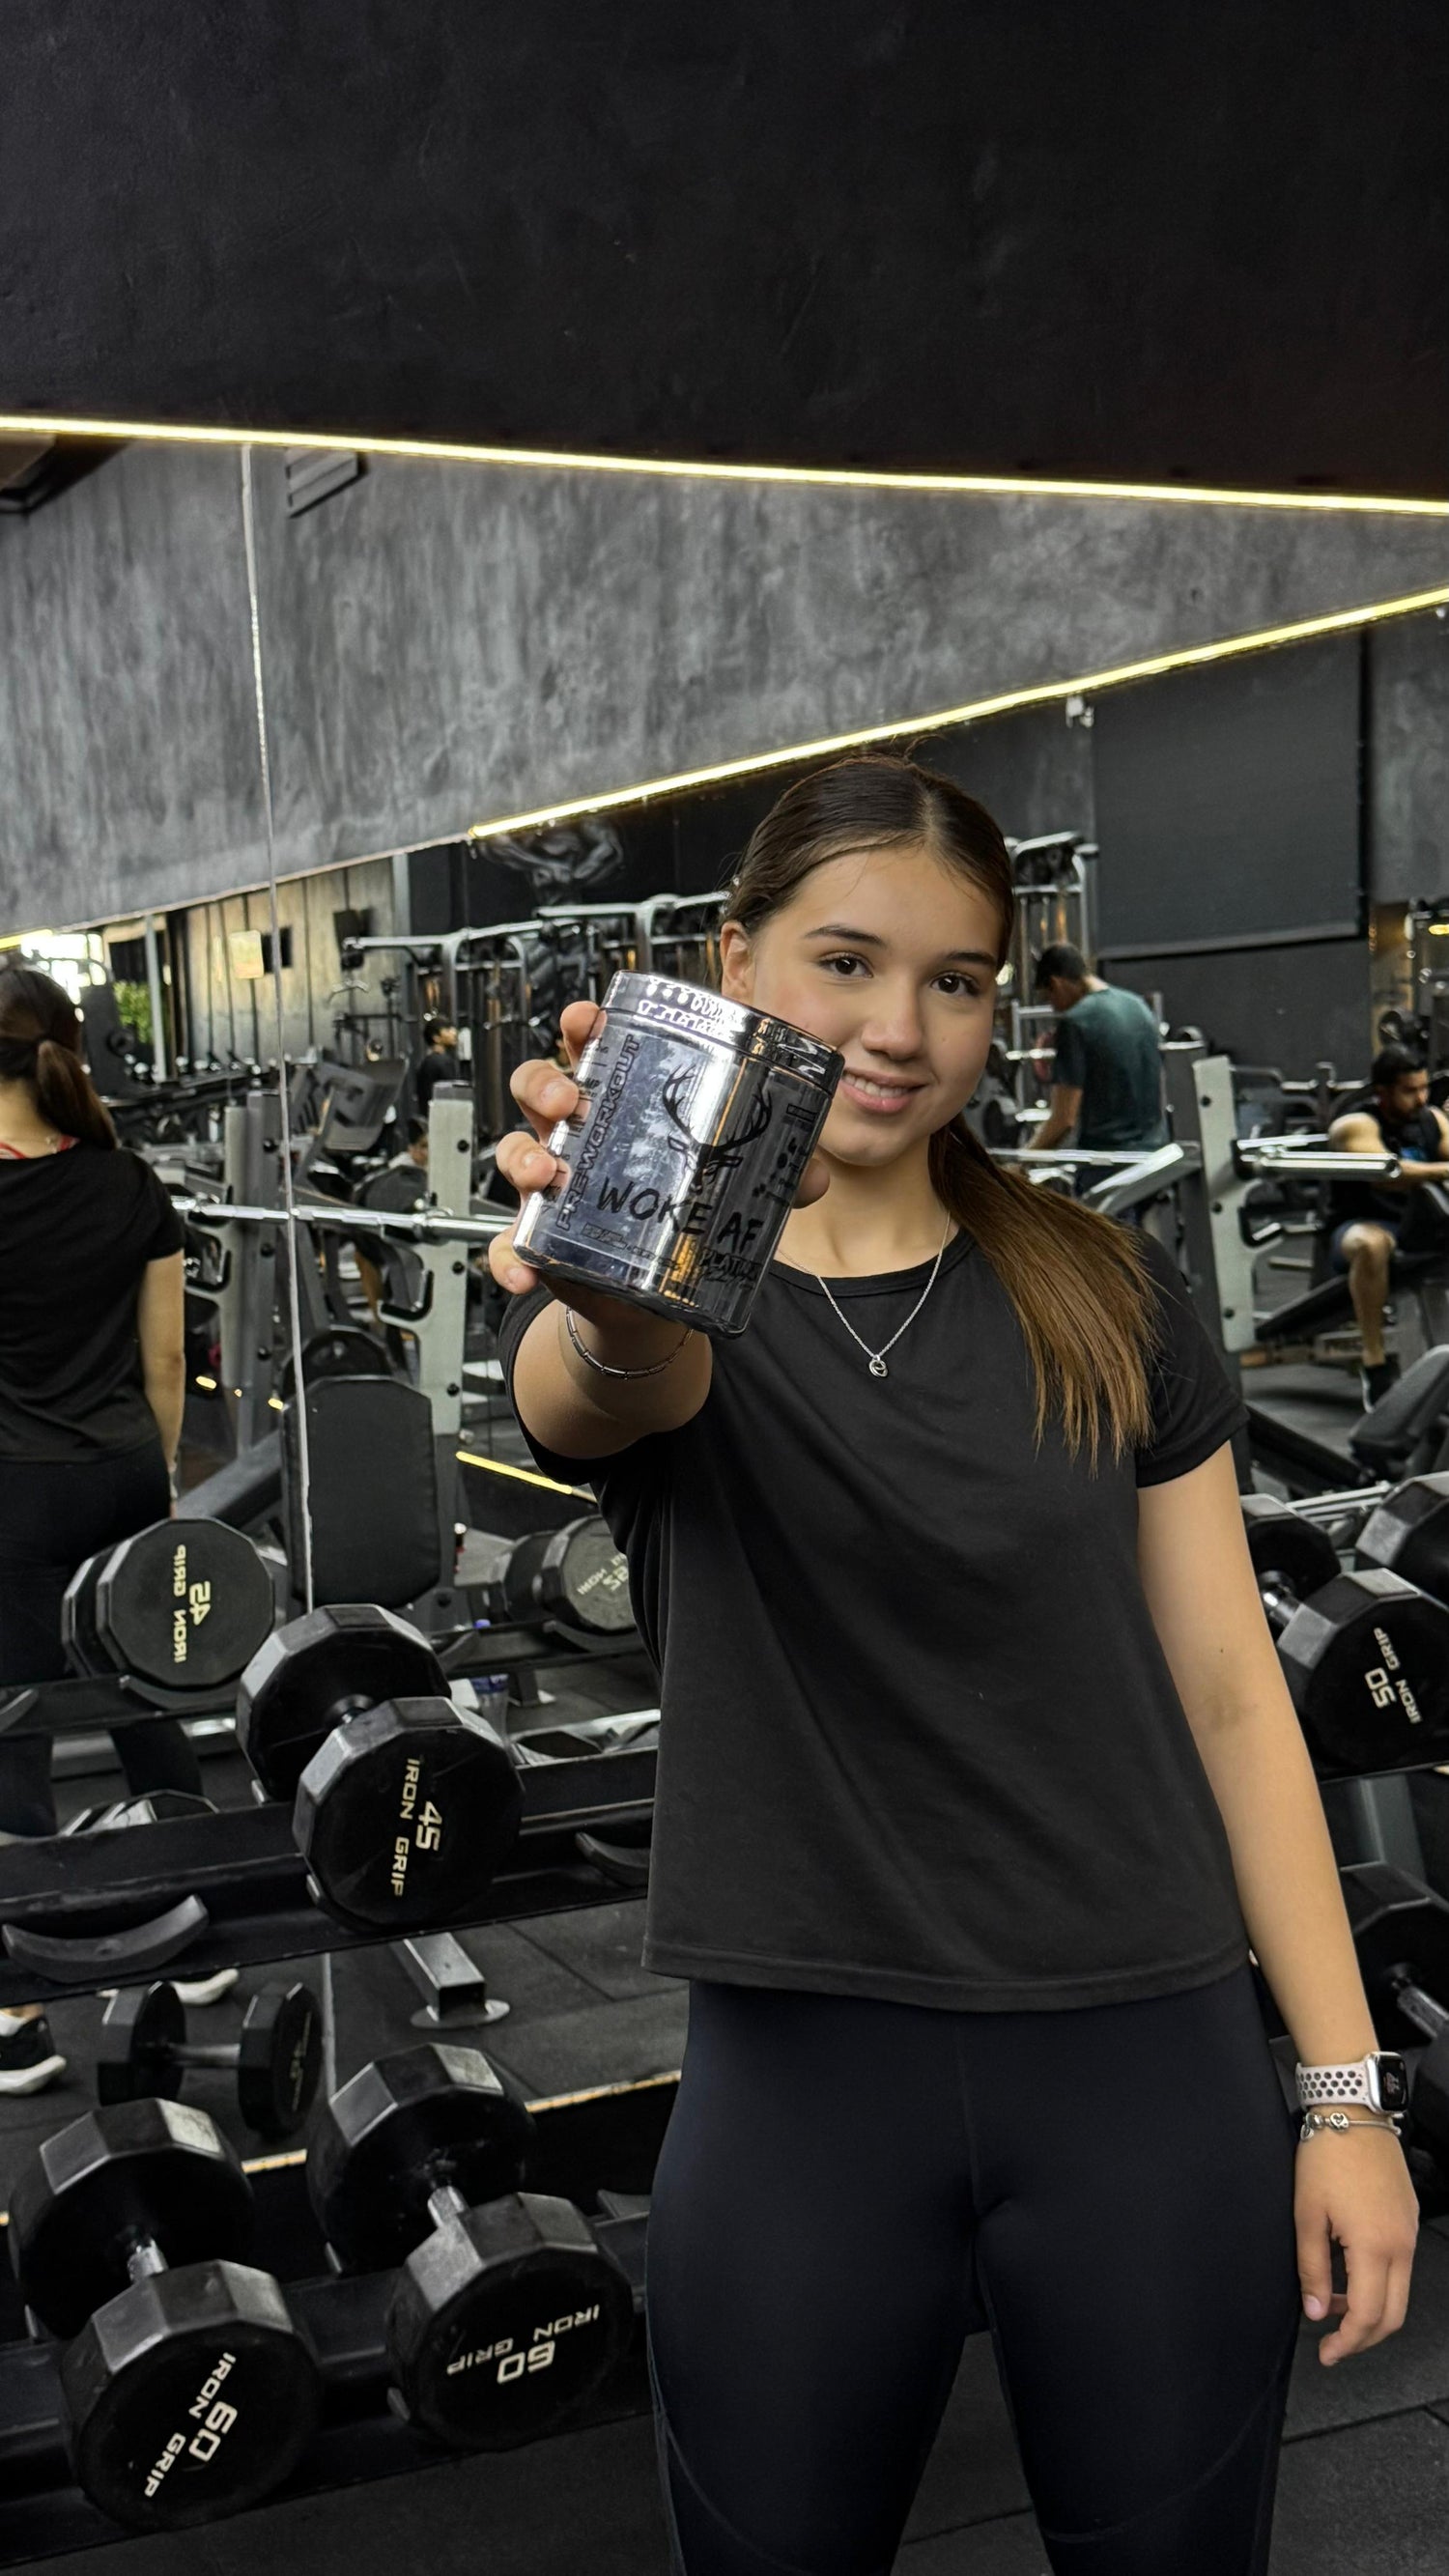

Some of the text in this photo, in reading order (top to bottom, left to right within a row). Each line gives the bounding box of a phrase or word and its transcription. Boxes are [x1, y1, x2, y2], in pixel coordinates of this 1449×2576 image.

[596, 1176, 713, 1234] WOKE
[717, 1211, 764, 1253] AF
[1364, 1666, 1397, 1709] 50
[1373, 1627, 1422, 1724] IRON GRIP
[390, 1758, 420, 1897] IRON GRIP
[415, 1800, 443, 1852] 45
[446, 2304, 600, 2376] IRON GRIP
[496, 2339, 555, 2385] 60
[144, 2352, 236, 2498] IRON GRIP
[188, 2401, 238, 2462] 60
